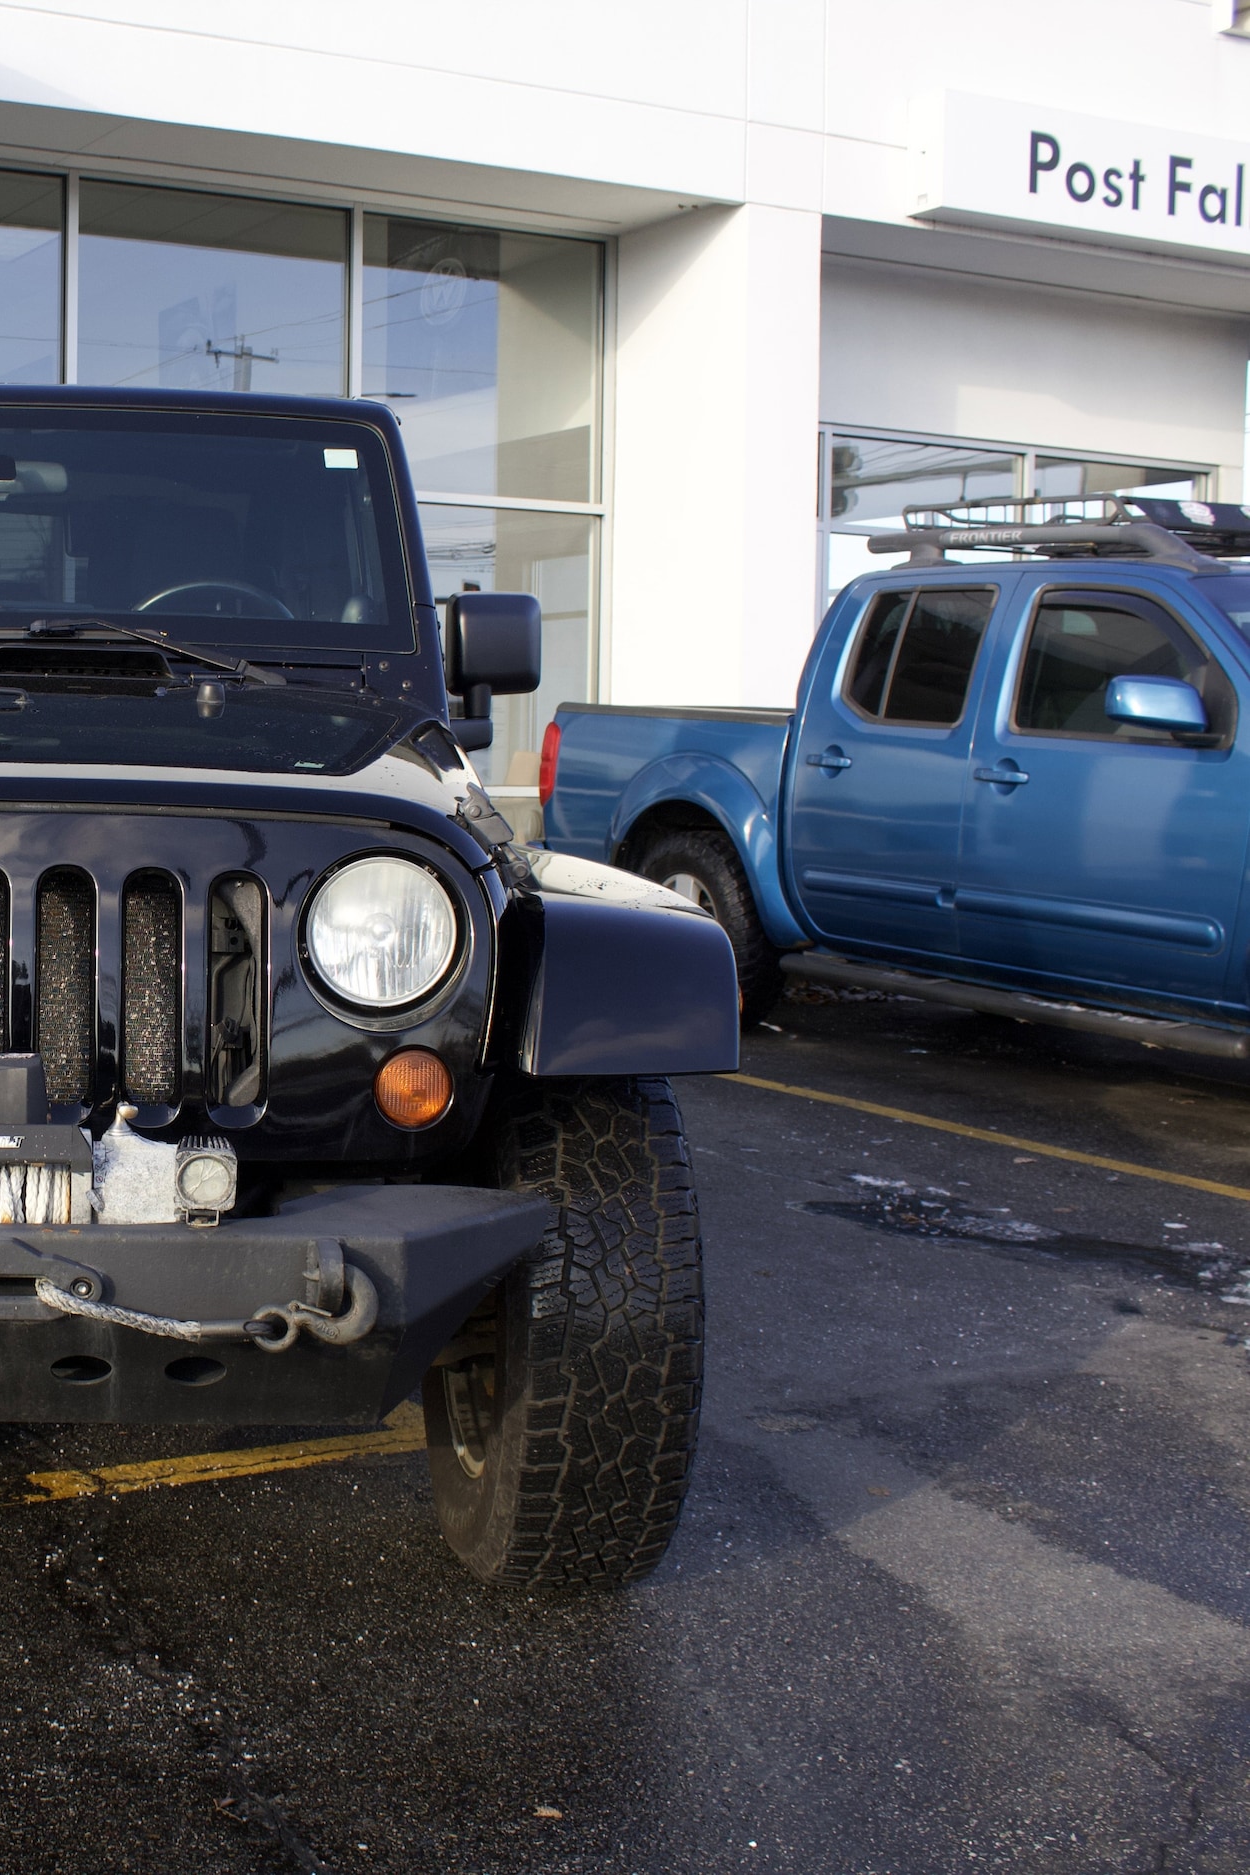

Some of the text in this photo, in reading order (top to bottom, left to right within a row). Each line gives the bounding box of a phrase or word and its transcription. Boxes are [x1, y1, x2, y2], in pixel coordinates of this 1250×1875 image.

[1029, 130, 1244, 227] Post Fal
[950, 530, 1023, 544] FRONTIER
